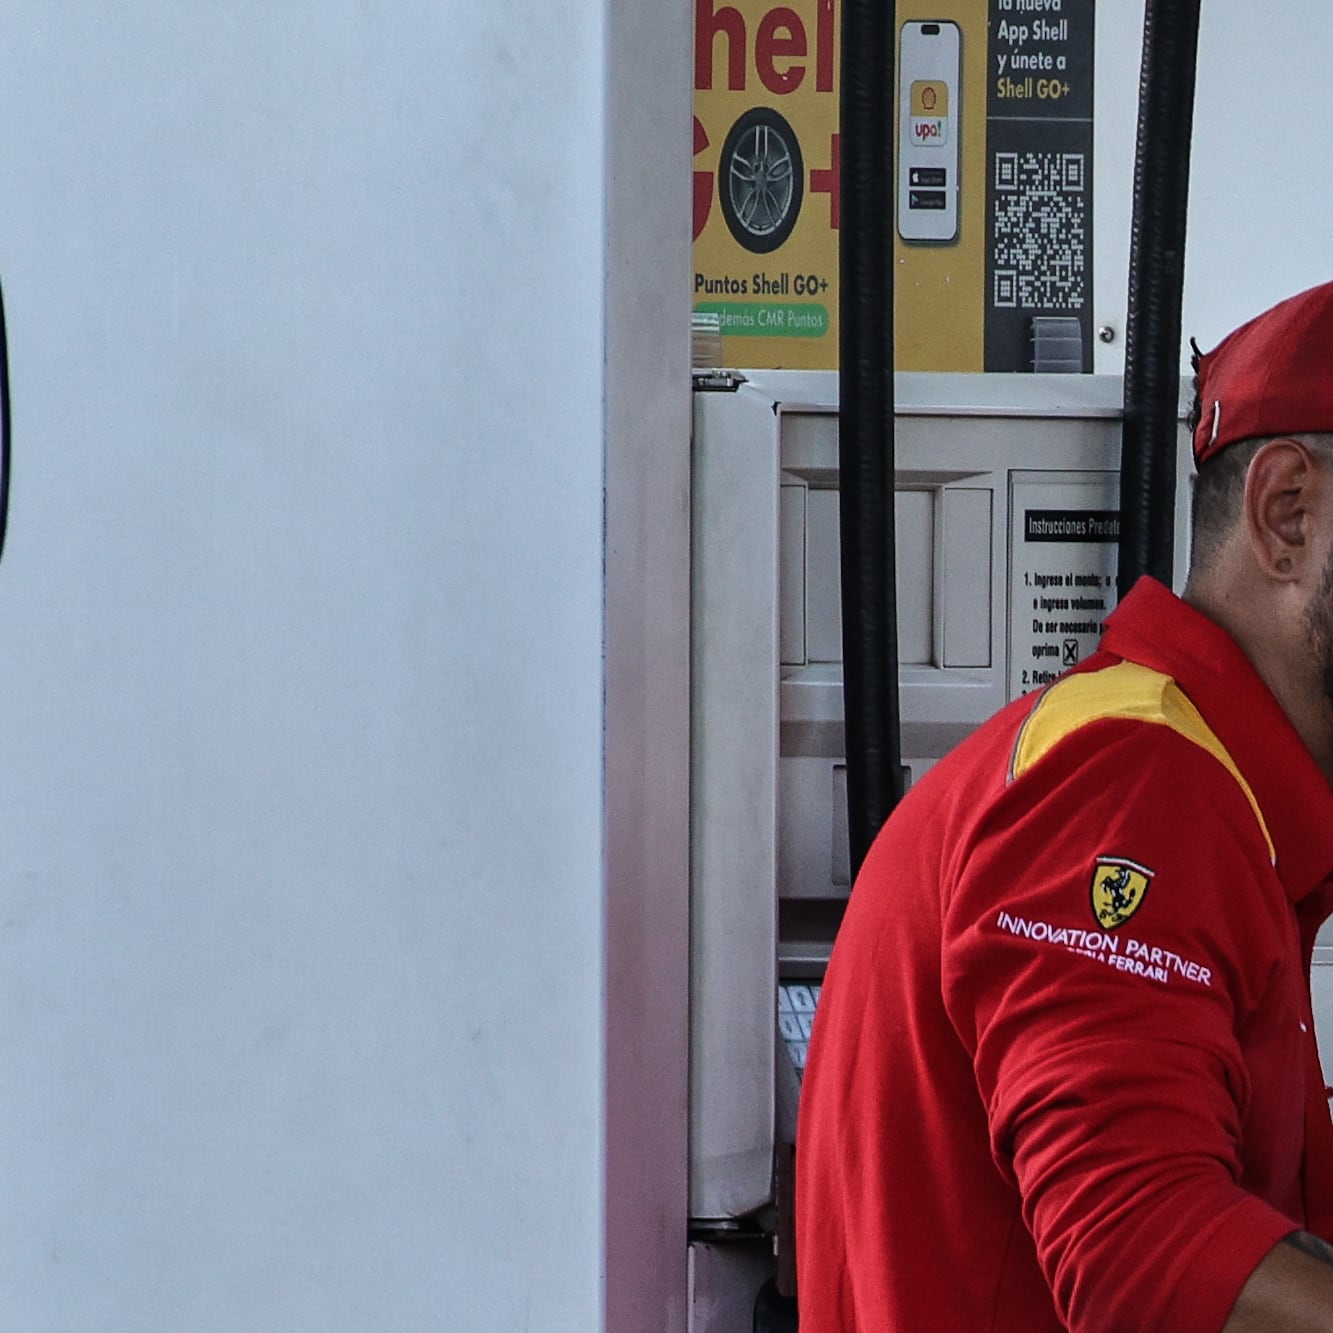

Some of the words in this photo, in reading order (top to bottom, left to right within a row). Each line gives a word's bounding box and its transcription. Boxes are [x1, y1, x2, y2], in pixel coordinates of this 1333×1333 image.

[1016, 0, 1061, 11] nueva
[997, 19, 1028, 45] App
[1032, 18, 1067, 40] Shell
[695, 0, 834, 94] hel
[997, 54, 1007, 75] y
[1011, 48, 1053, 69] únete
[1056, 56, 1066, 70] a
[997, 77, 1032, 98] Shell
[1037, 79, 1070, 99] GO+
[915, 121, 942, 141] upa!
[695, 273, 748, 294] Puntos
[752, 272, 788, 295] Shell
[793, 274, 828, 296] GO+
[714, 306, 754, 327] demás
[757, 309, 784, 327] CMR
[788, 310, 824, 327] Puntos
[1028, 517, 1087, 535] Instrucciones
[1024, 572, 1032, 587] 1.
[1032, 643, 1059, 659] oprima
[1022, 670, 1030, 685] 2.
[997, 911, 1118, 953] INNOVATION
[1125, 939, 1212, 987] PARTNER
[1107, 953, 1168, 984] FERRARI
